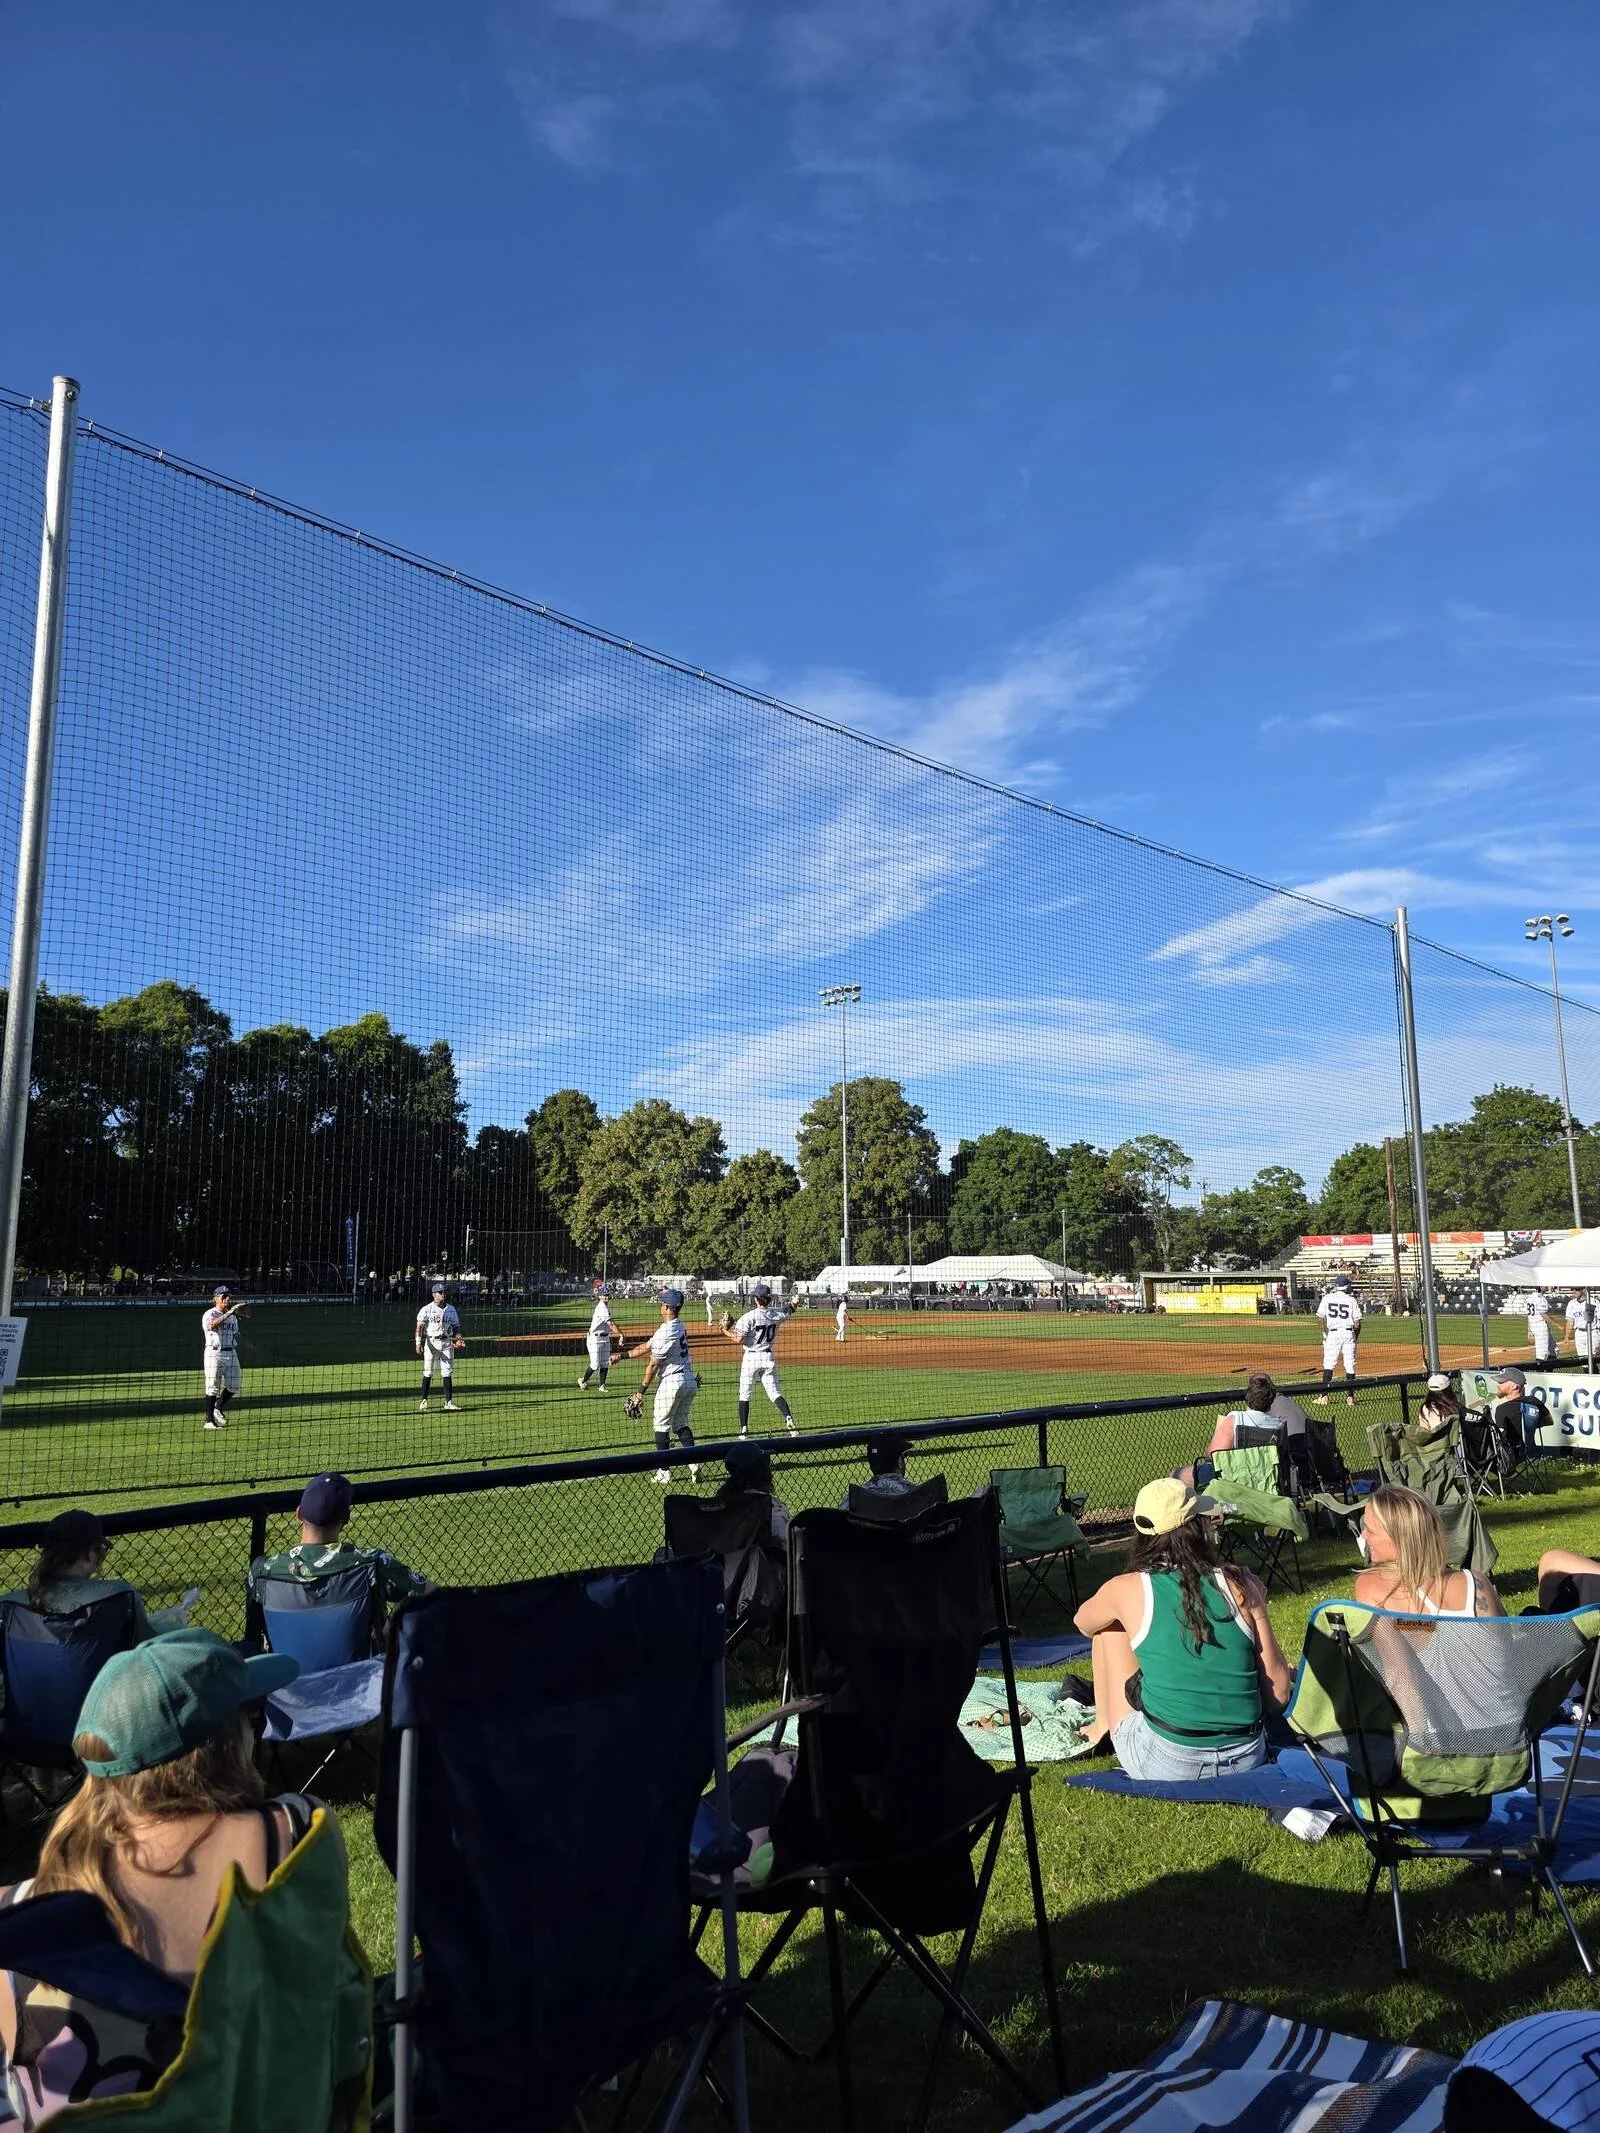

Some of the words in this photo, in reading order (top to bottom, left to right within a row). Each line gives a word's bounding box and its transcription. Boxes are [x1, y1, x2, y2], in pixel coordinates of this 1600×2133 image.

[1328, 1303, 1350, 1320] 55
[755, 1324, 777, 1345] 70
[1530, 1386, 1563, 1409] OT
[1561, 1413, 1600, 1437] SU
